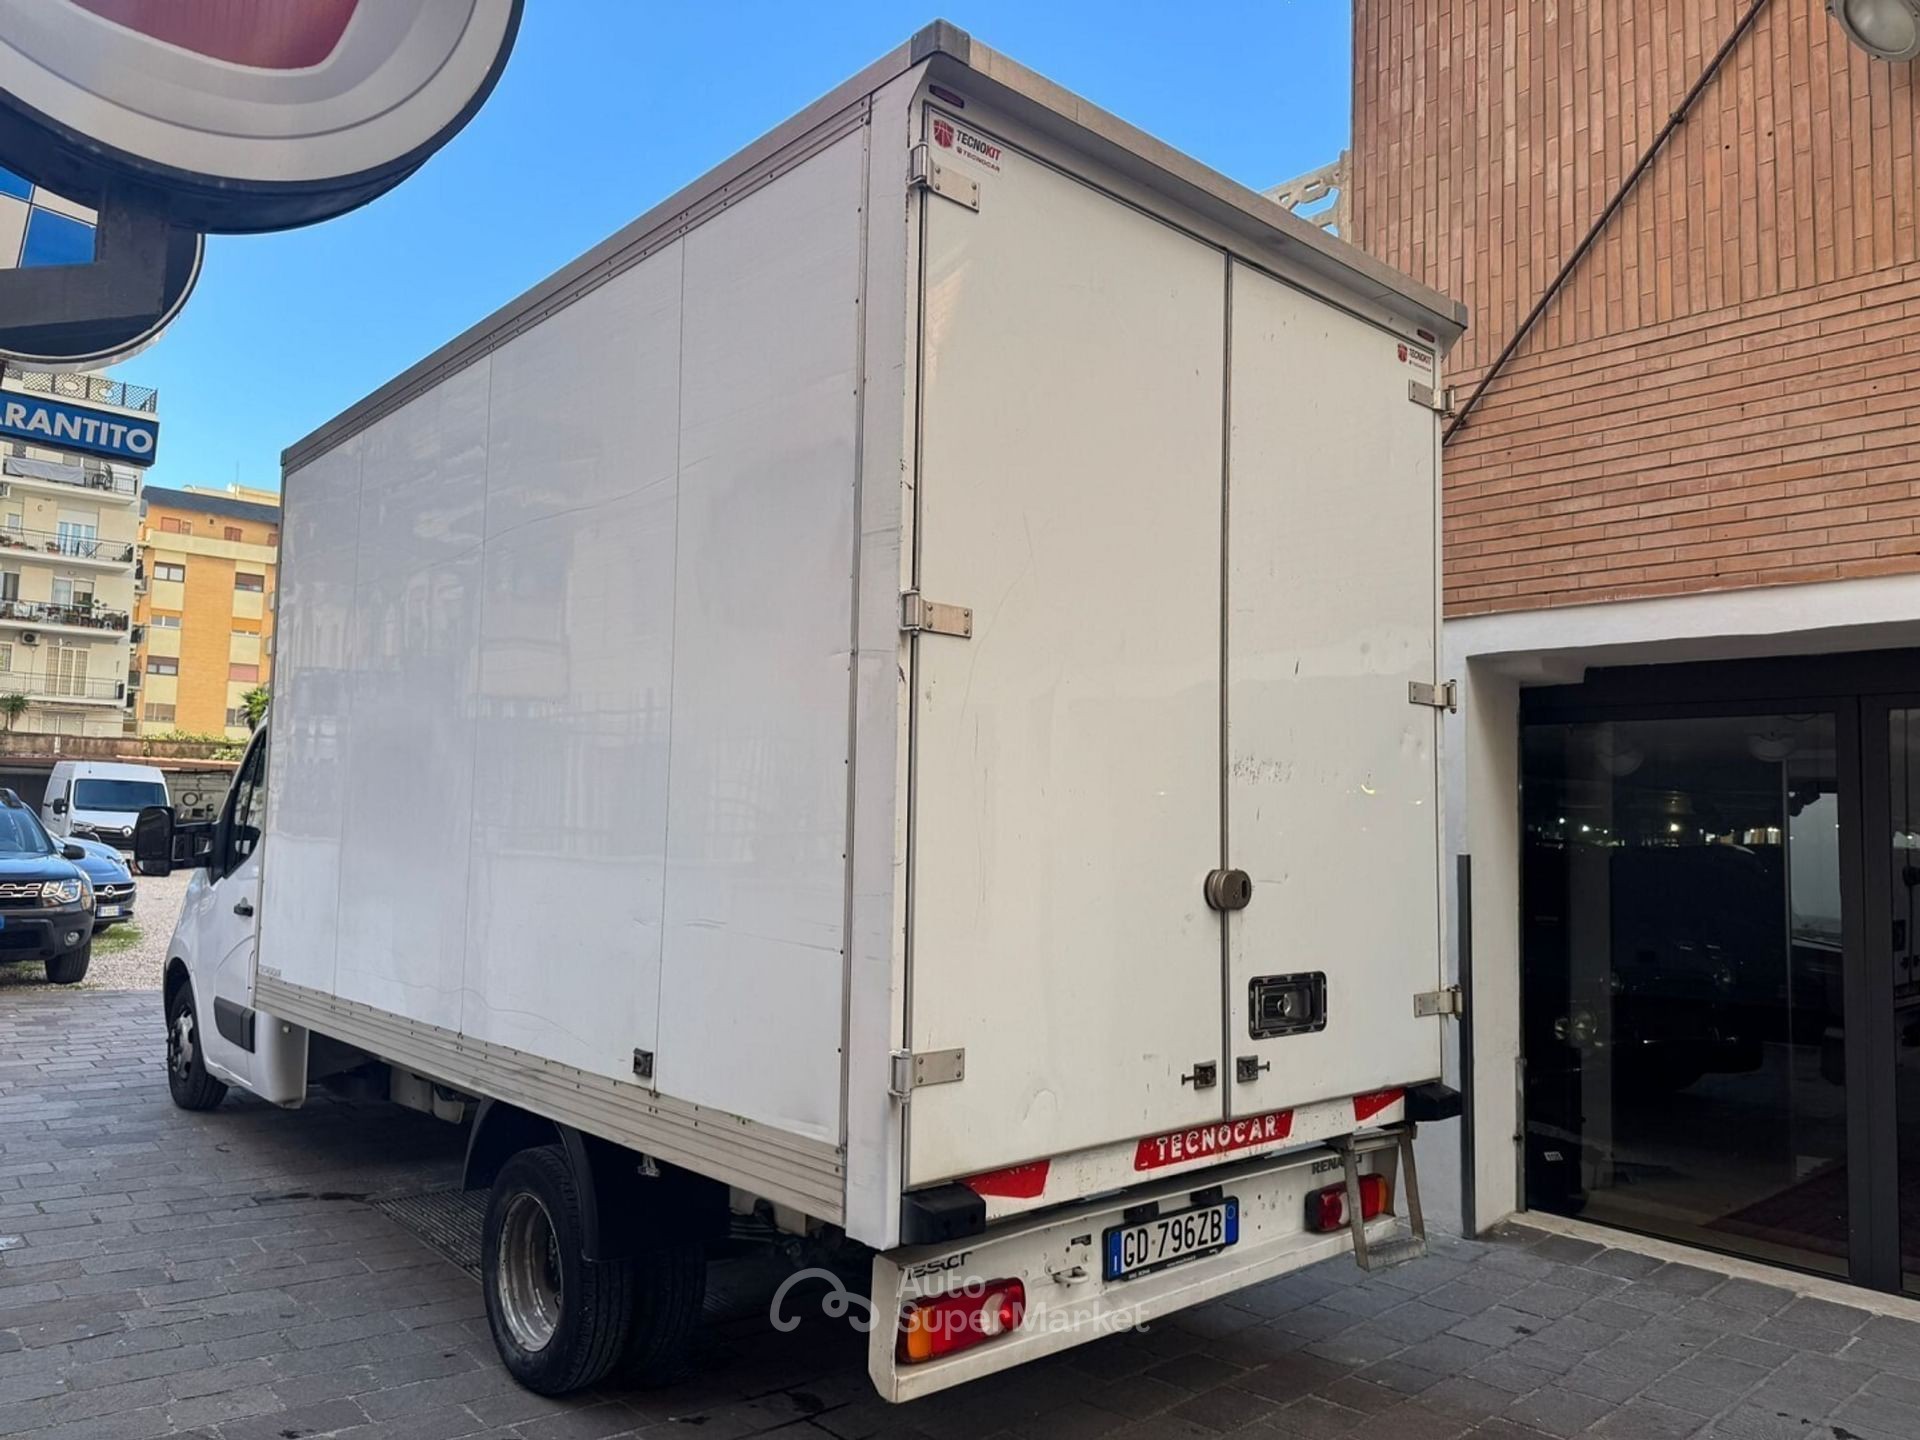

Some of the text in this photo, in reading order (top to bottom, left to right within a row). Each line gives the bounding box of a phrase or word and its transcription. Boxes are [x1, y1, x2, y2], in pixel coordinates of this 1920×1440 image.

[956, 129, 1002, 161] TECNOKIT
[0, 401, 154, 454] RANTITO
[1156, 1115, 1277, 1161] TECNOCAR
[1123, 1209, 1223, 1268] GD 796ZB
